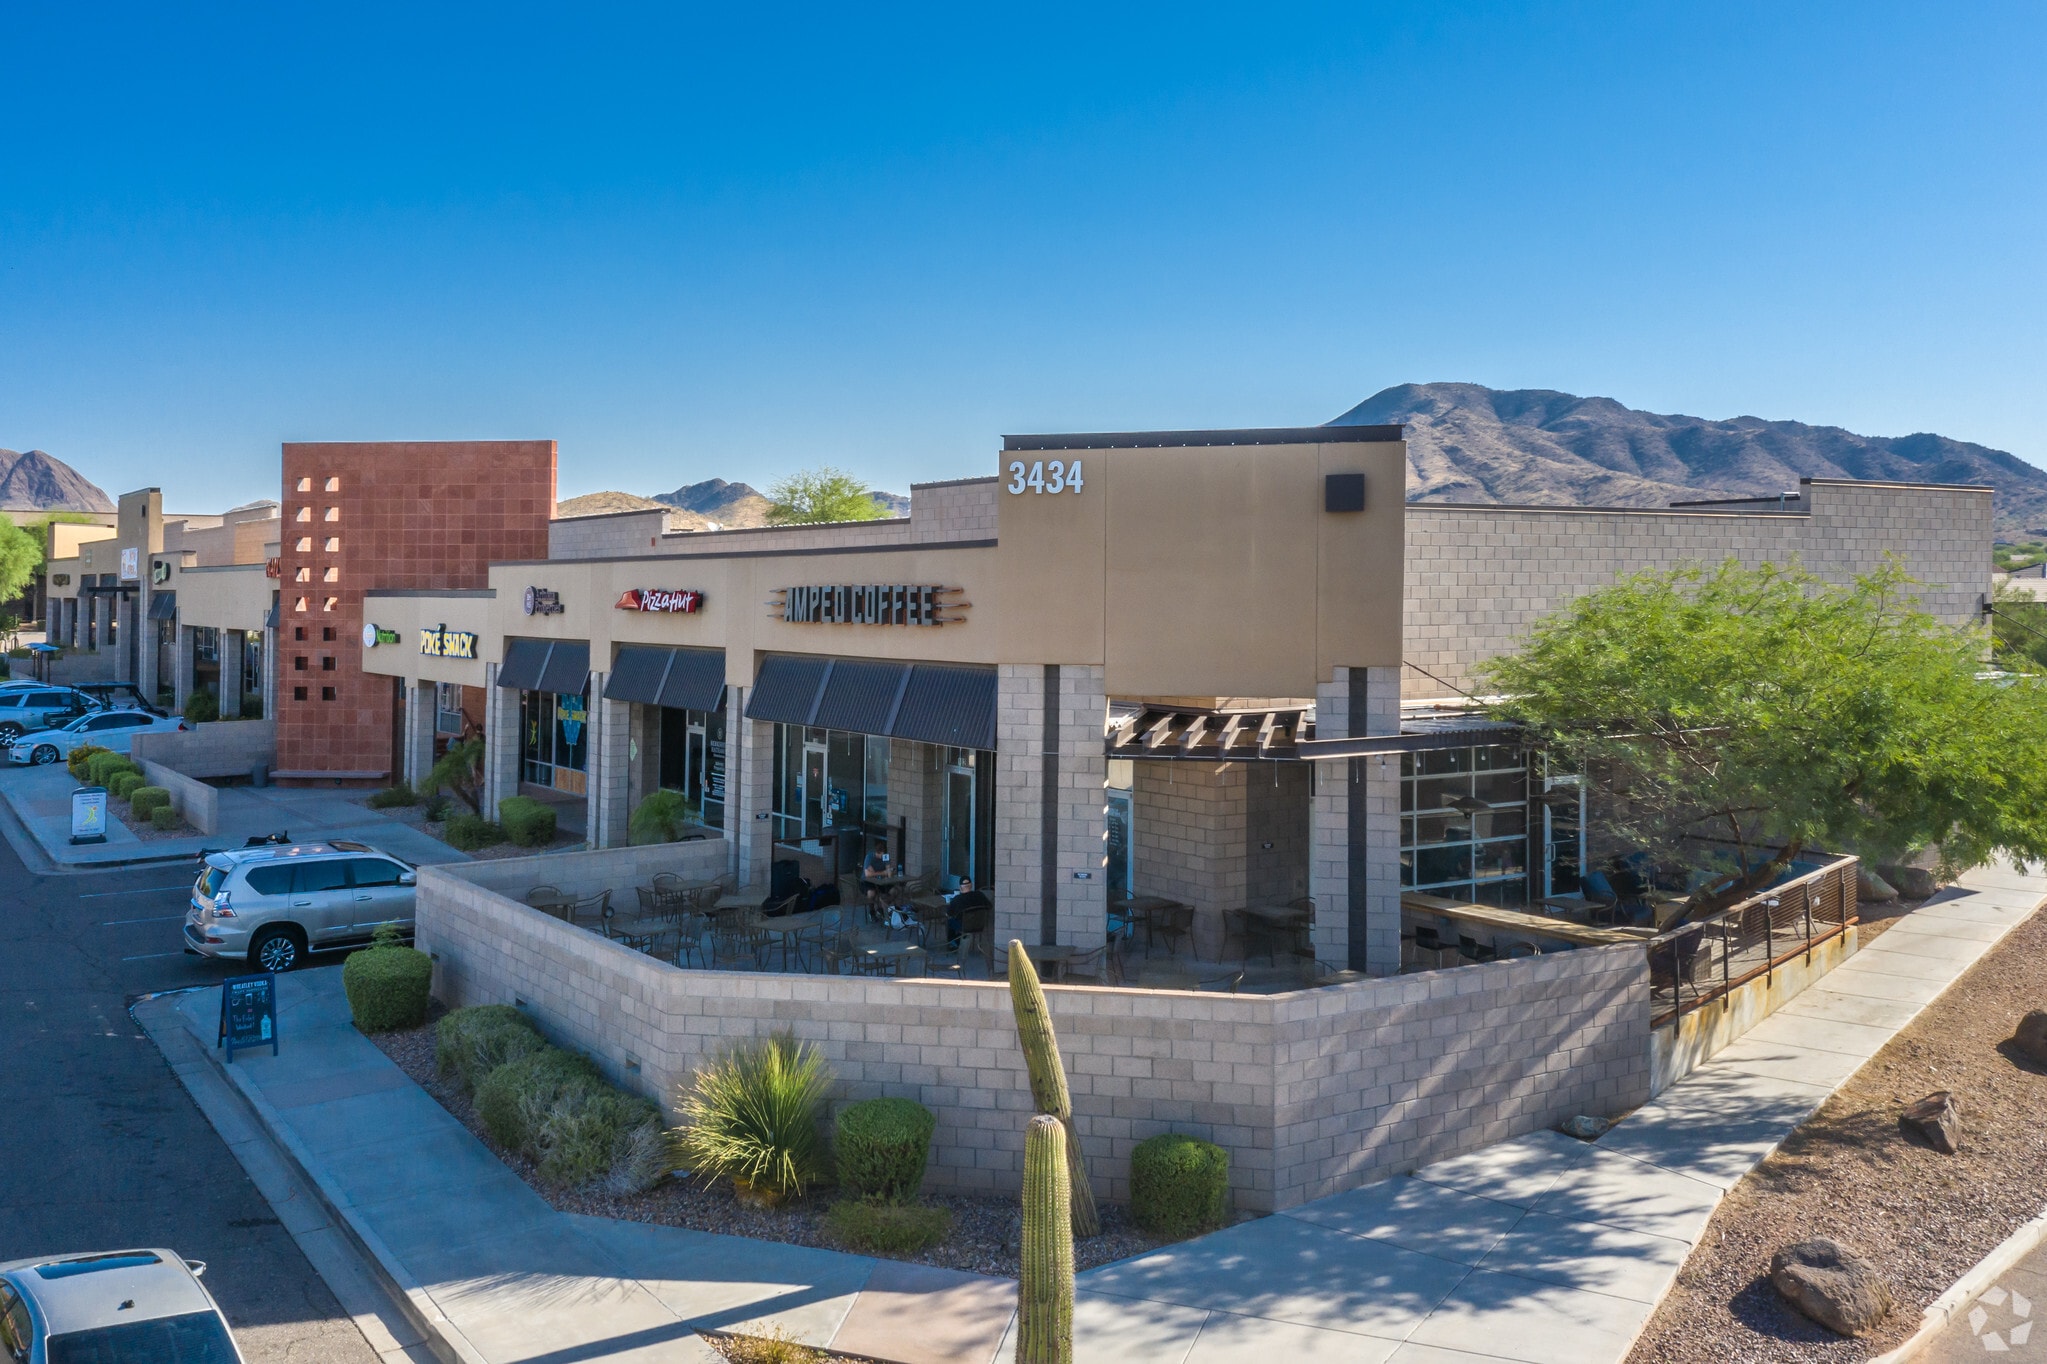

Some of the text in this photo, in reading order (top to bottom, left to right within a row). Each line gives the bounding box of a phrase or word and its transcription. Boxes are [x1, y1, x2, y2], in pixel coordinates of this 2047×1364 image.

[1007, 460, 1084, 495] 3434
[640, 590, 694, 613] Pizza Hut
[784, 585, 933, 626] AMPED COFFEE
[419, 623, 474, 658] POKÉ SHACK
